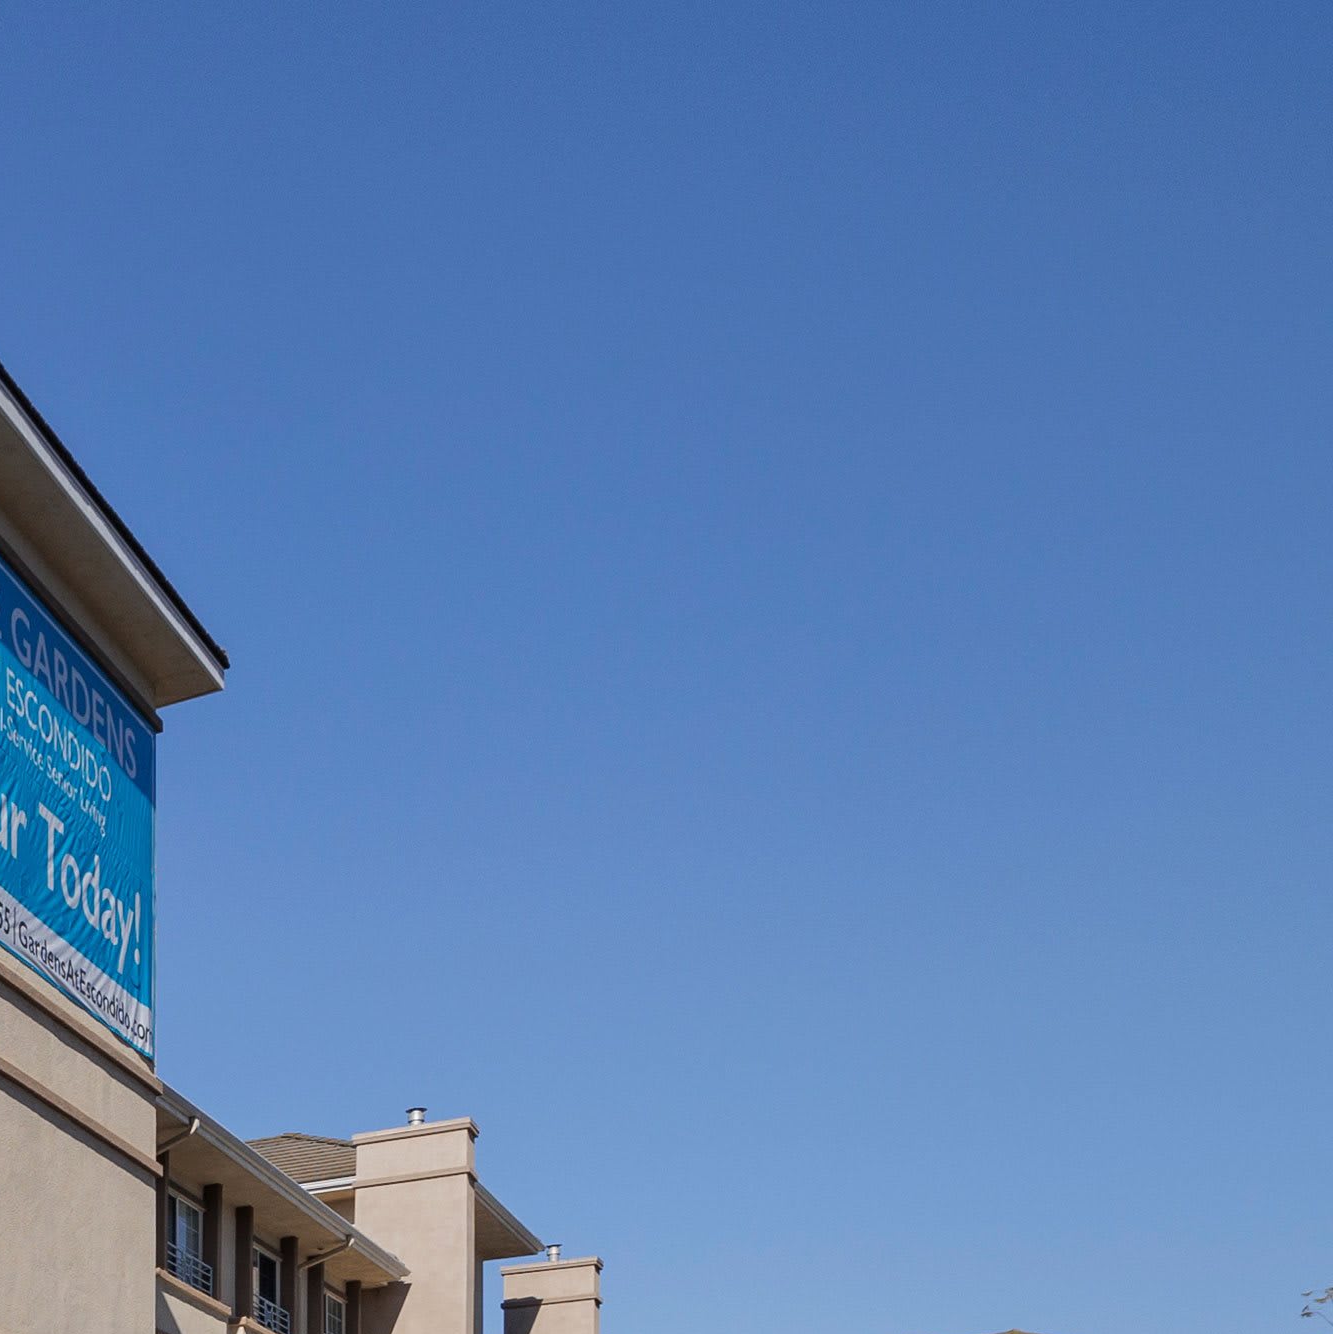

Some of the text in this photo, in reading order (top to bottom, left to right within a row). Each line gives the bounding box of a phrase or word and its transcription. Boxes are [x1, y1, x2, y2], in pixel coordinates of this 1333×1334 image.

[6, 667, 111, 802] ESCONDIDO
[11, 607, 137, 780] GARDENS
[47, 755, 78, 800] Senior
[80, 787, 106, 838] Living
[39, 802, 142, 974] Today!
